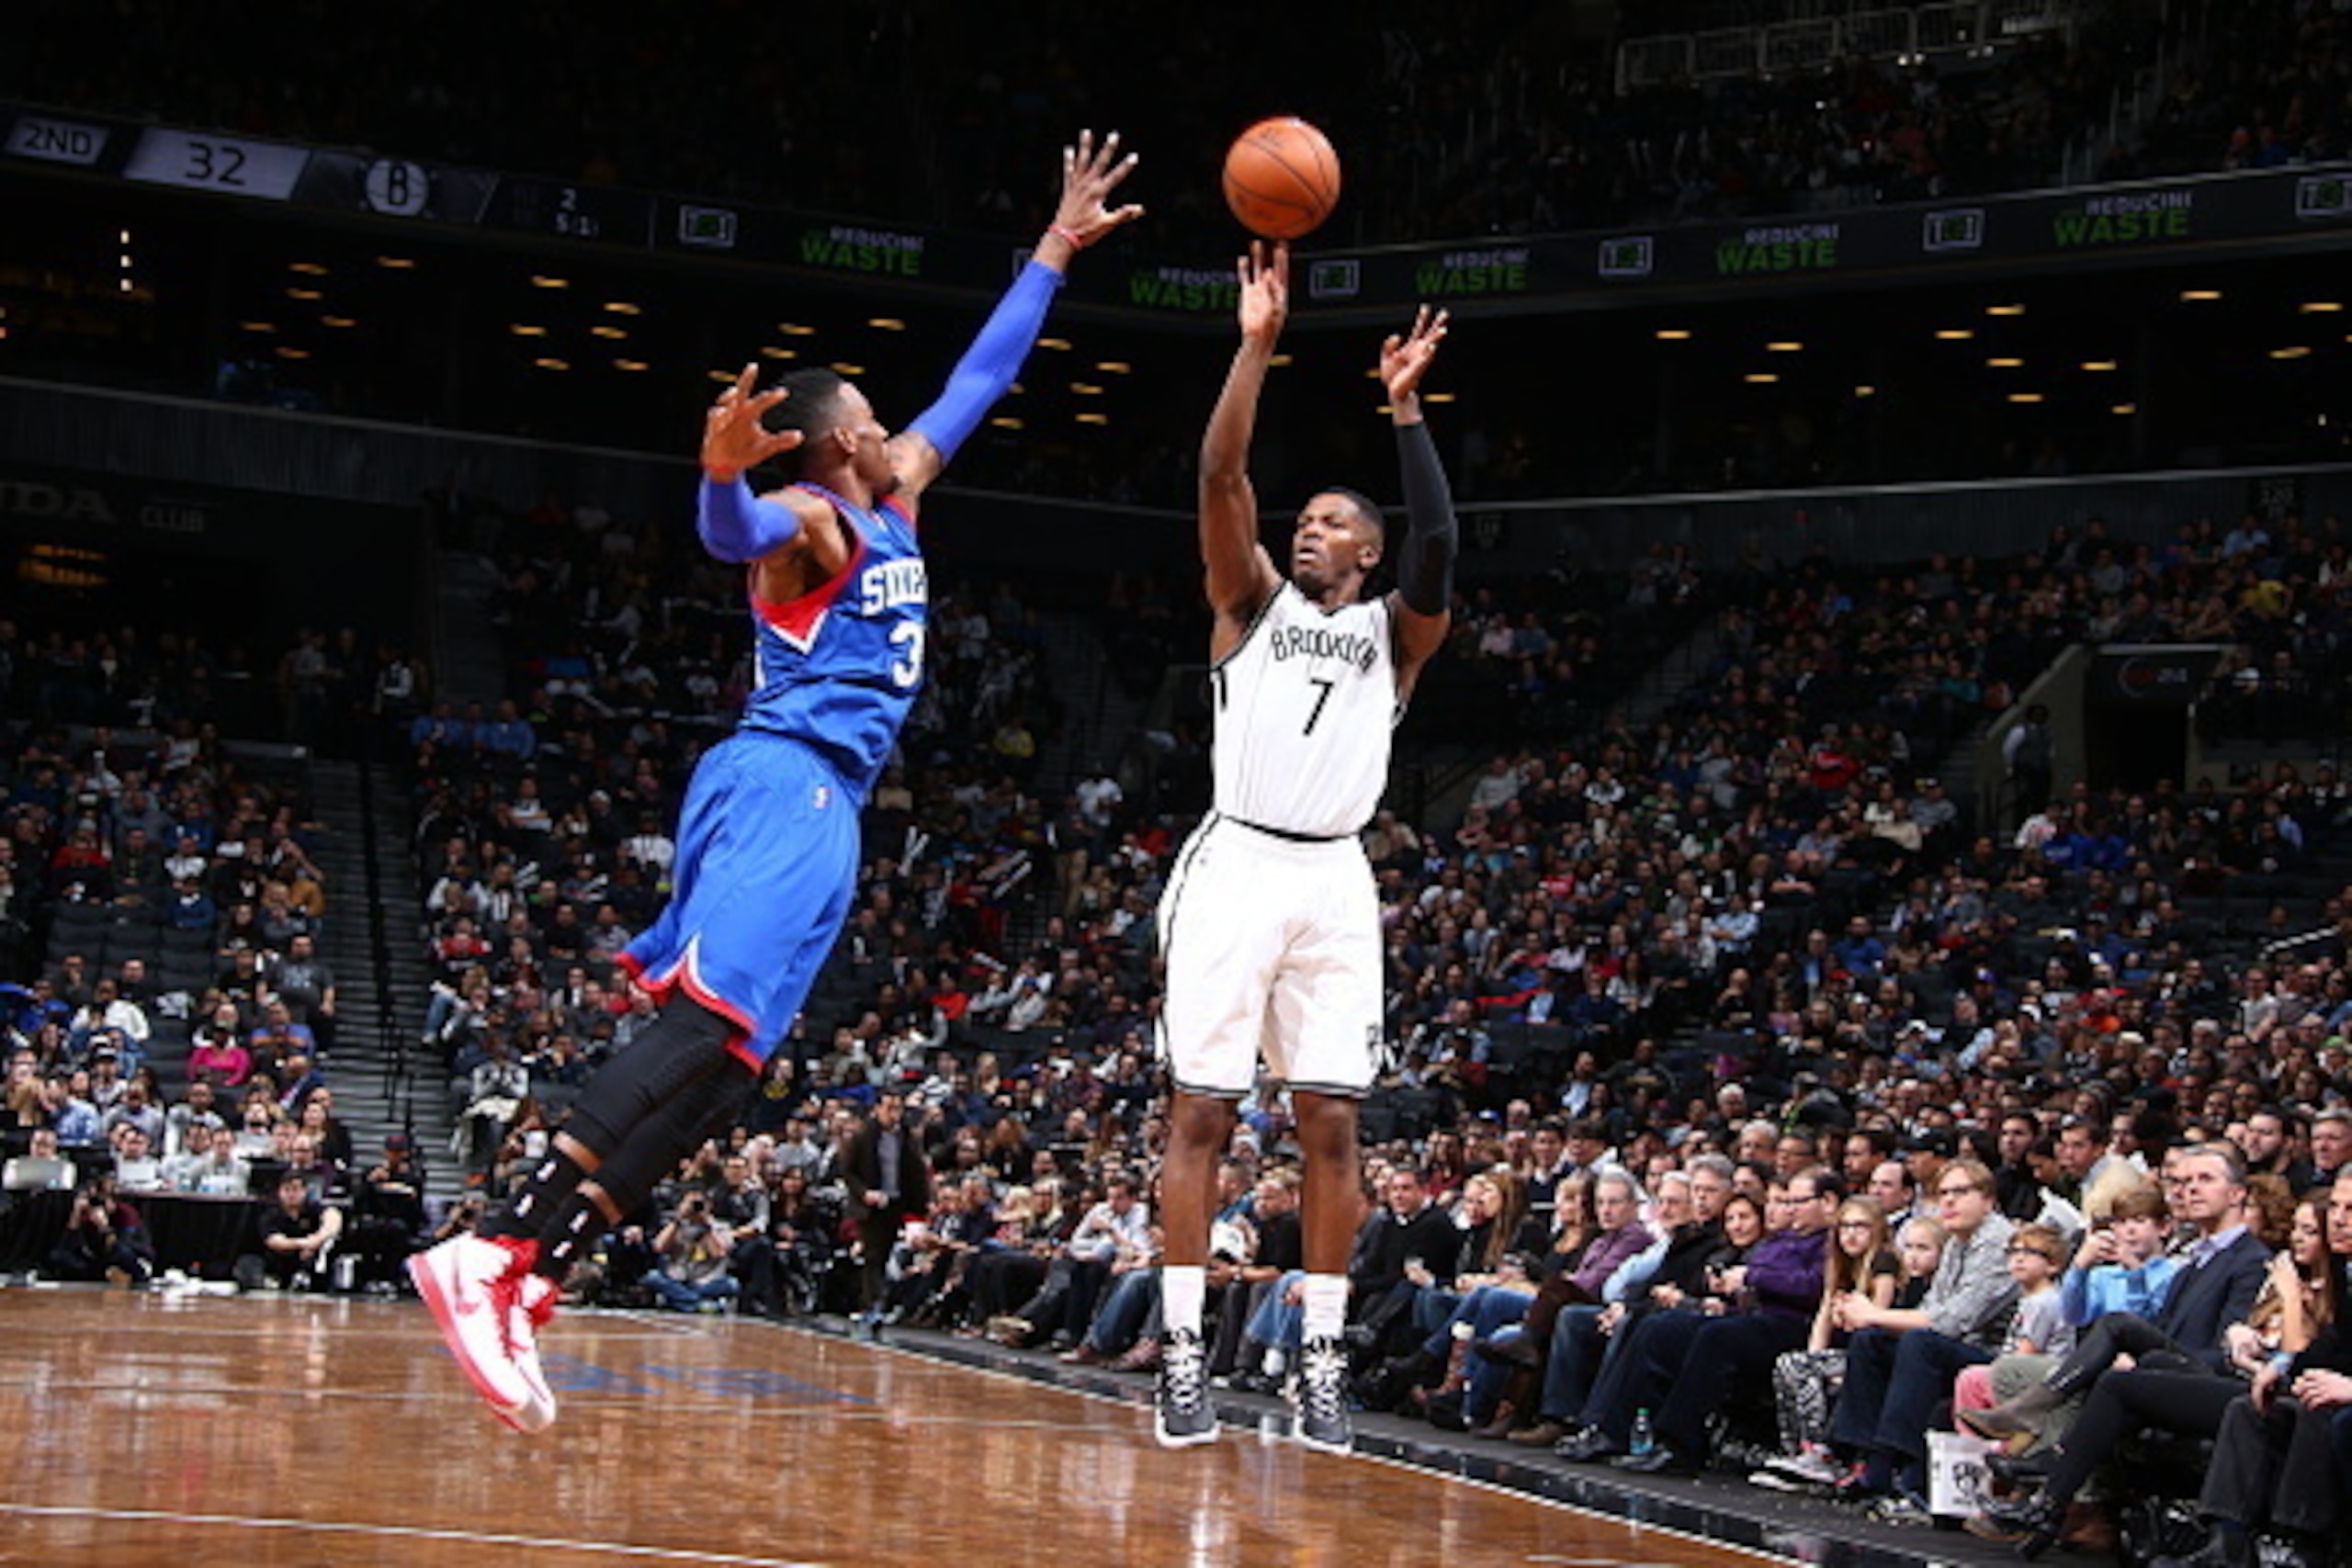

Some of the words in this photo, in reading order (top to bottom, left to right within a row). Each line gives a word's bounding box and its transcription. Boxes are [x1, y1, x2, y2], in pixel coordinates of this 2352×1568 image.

[24, 122, 91, 155] 2ND
[186, 141, 245, 186] 32
[560, 187, 579, 212] 2
[2052, 208, 2191, 246] WASTE
[797, 238, 922, 276] WASTE
[1714, 239, 1838, 275] WASTE
[1415, 264, 1528, 295] WASTE
[0, 479, 119, 526] DA
[141, 504, 205, 533] CLUB
[889, 619, 927, 687] 3
[1303, 677, 1335, 737] 7
